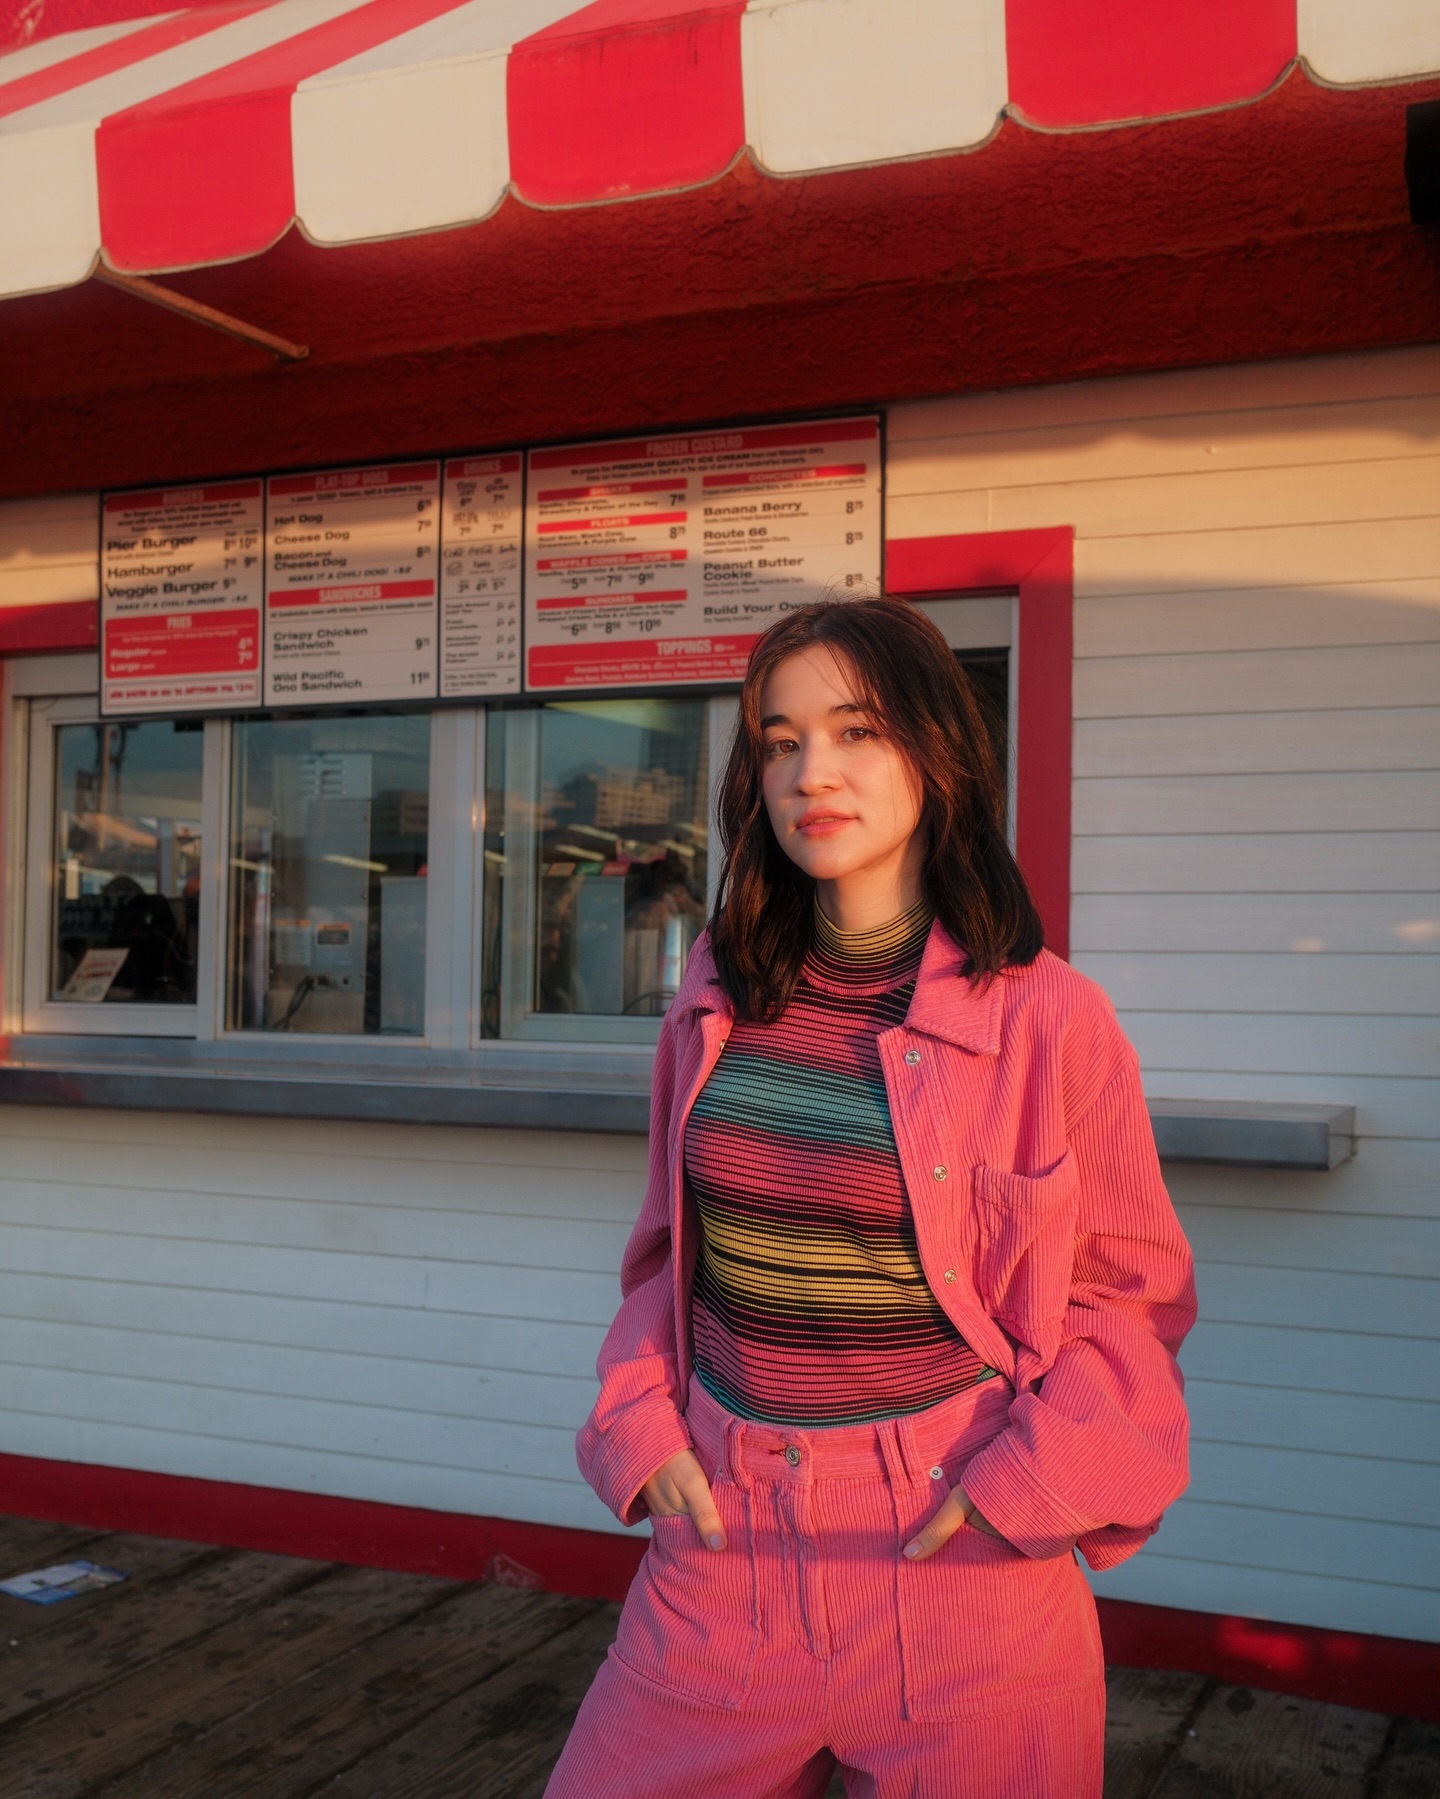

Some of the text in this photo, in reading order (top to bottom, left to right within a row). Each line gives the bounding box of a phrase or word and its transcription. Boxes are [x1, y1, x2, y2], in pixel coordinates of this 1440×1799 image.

[646, 434, 743, 457] FROZEN CUSTARD
[612, 462, 654, 472] PREMIUM
[656, 458, 695, 468] QUALITY
[716, 453, 749, 462] CREAM
[538, 508, 582, 518] Strawberry
[703, 500, 803, 517] Banana Berry
[845, 500, 863, 515] 875
[274, 513, 323, 525] Hot Dog
[588, 518, 630, 529] FLOATS
[274, 530, 350, 545] Cheese Dog
[619, 536, 637, 544] Cow
[669, 526, 685, 540] 875
[703, 527, 768, 541] Route 66
[845, 531, 863, 546] 875
[107, 535, 197, 552] Pier Burger
[274, 551, 313, 561] Bacon
[549, 559, 587, 569] WAFFLE
[590, 556, 627, 566] CONES
[642, 552, 672, 562] CUPS
[274, 557, 347, 572] Cheese Dog
[703, 557, 804, 574] Peanut Butter
[107, 562, 194, 583] Hamburger
[703, 570, 752, 582] Cookie
[105, 580, 217, 601] Veggie Burger
[584, 595, 634, 605] SUNDAES
[703, 602, 801, 617] Build Your Ow
[273, 627, 368, 644] Crispy Chicken
[273, 640, 334, 652] Sandwich
[656, 640, 711, 656] TOPPINGS
[110, 662, 141, 674] Large
[272, 670, 344, 683] Wild Pacific
[273, 679, 362, 693] Ono Sandwich
